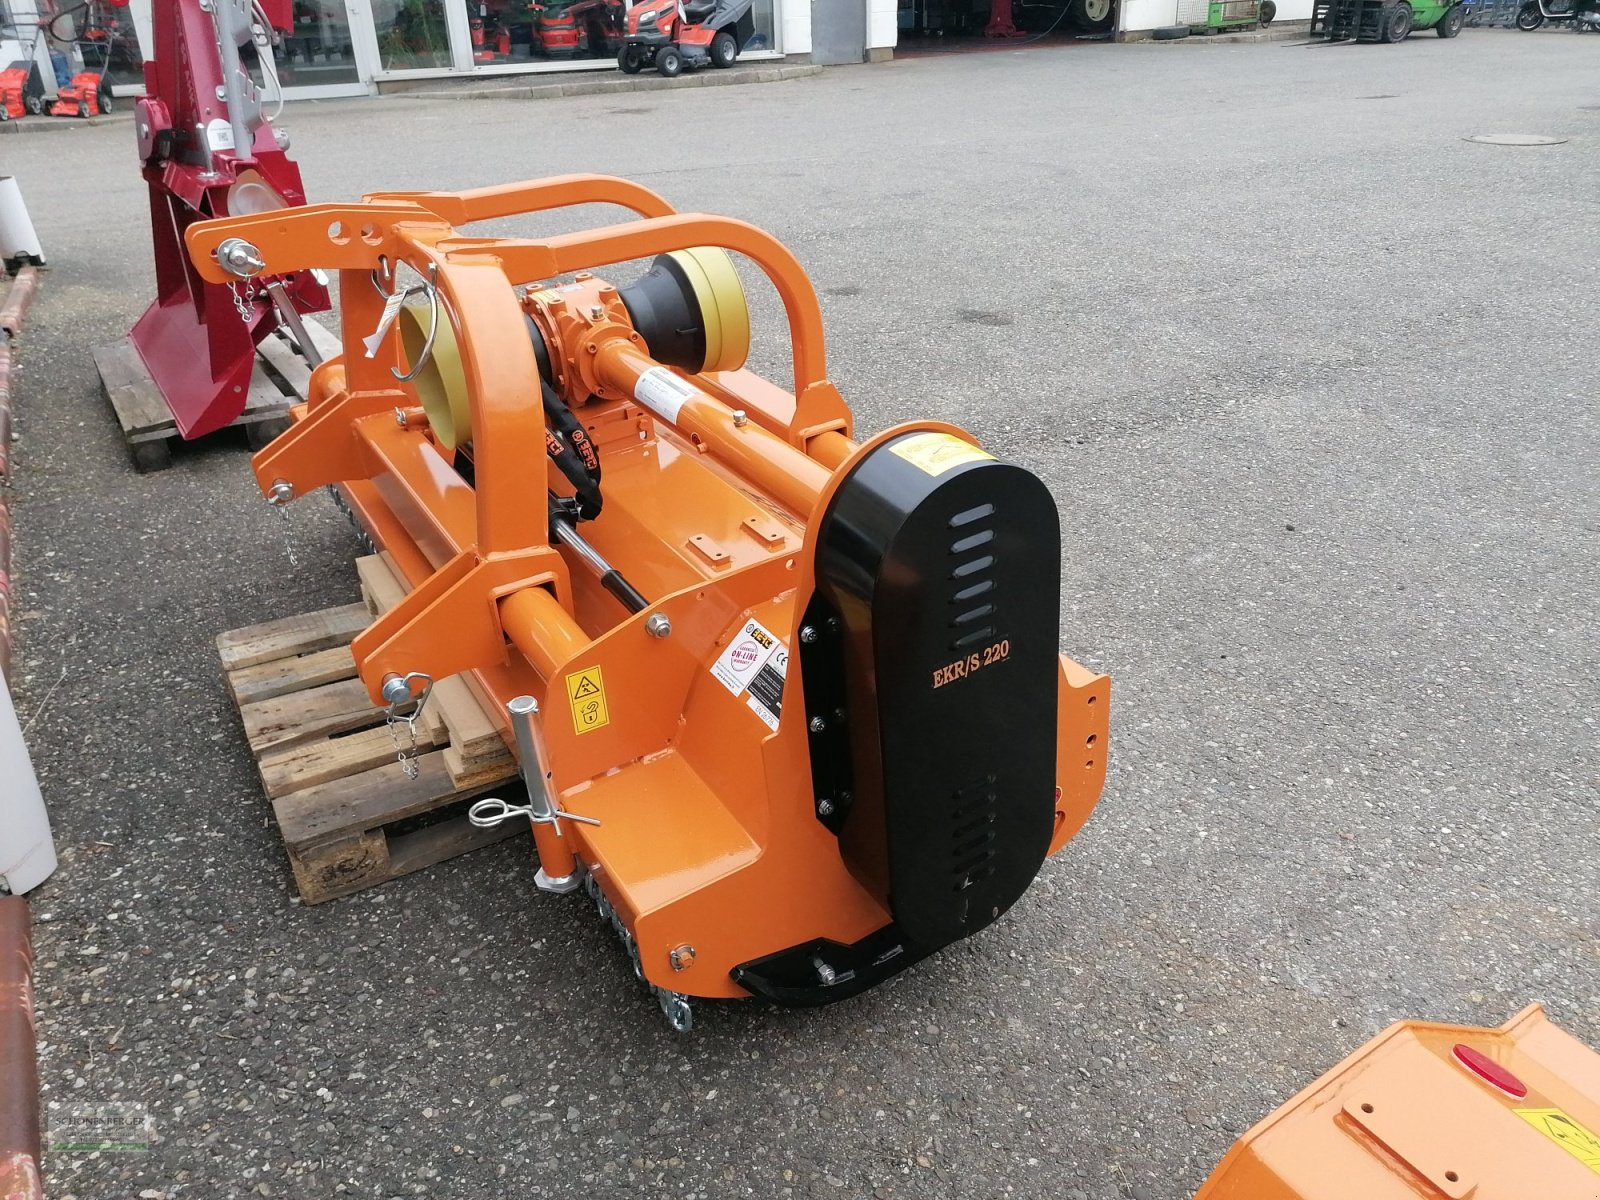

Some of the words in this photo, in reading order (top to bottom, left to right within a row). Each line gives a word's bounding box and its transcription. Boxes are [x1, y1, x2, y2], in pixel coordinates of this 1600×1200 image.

[732, 650, 757, 661] ON-LINE
[933, 653, 980, 689] EKR/S
[984, 640, 1009, 666] 220
